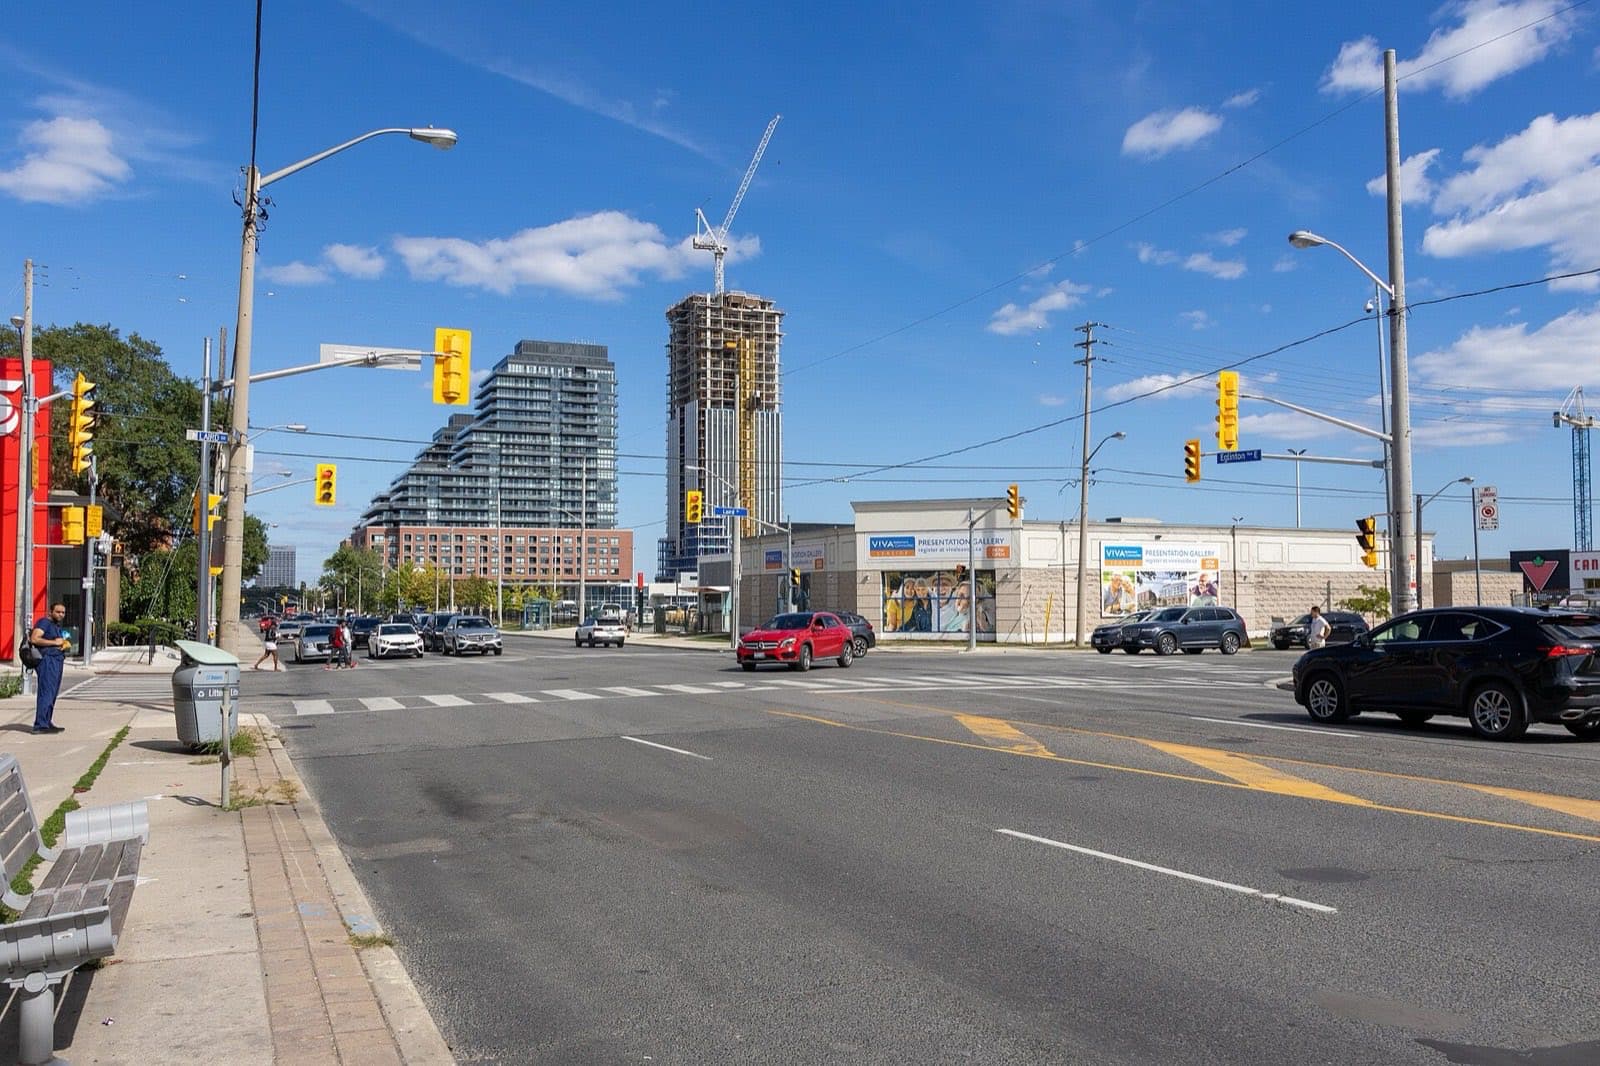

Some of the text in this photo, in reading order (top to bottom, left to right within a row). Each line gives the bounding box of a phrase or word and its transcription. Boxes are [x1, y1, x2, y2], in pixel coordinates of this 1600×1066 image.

[871, 540, 895, 548] VIVA
[918, 538, 970, 547] PRESENTATION
[1105, 549, 1125, 557] VIVA
[1145, 549, 1189, 557] PRESENTATION
[1189, 549, 1215, 557] GALLERY
